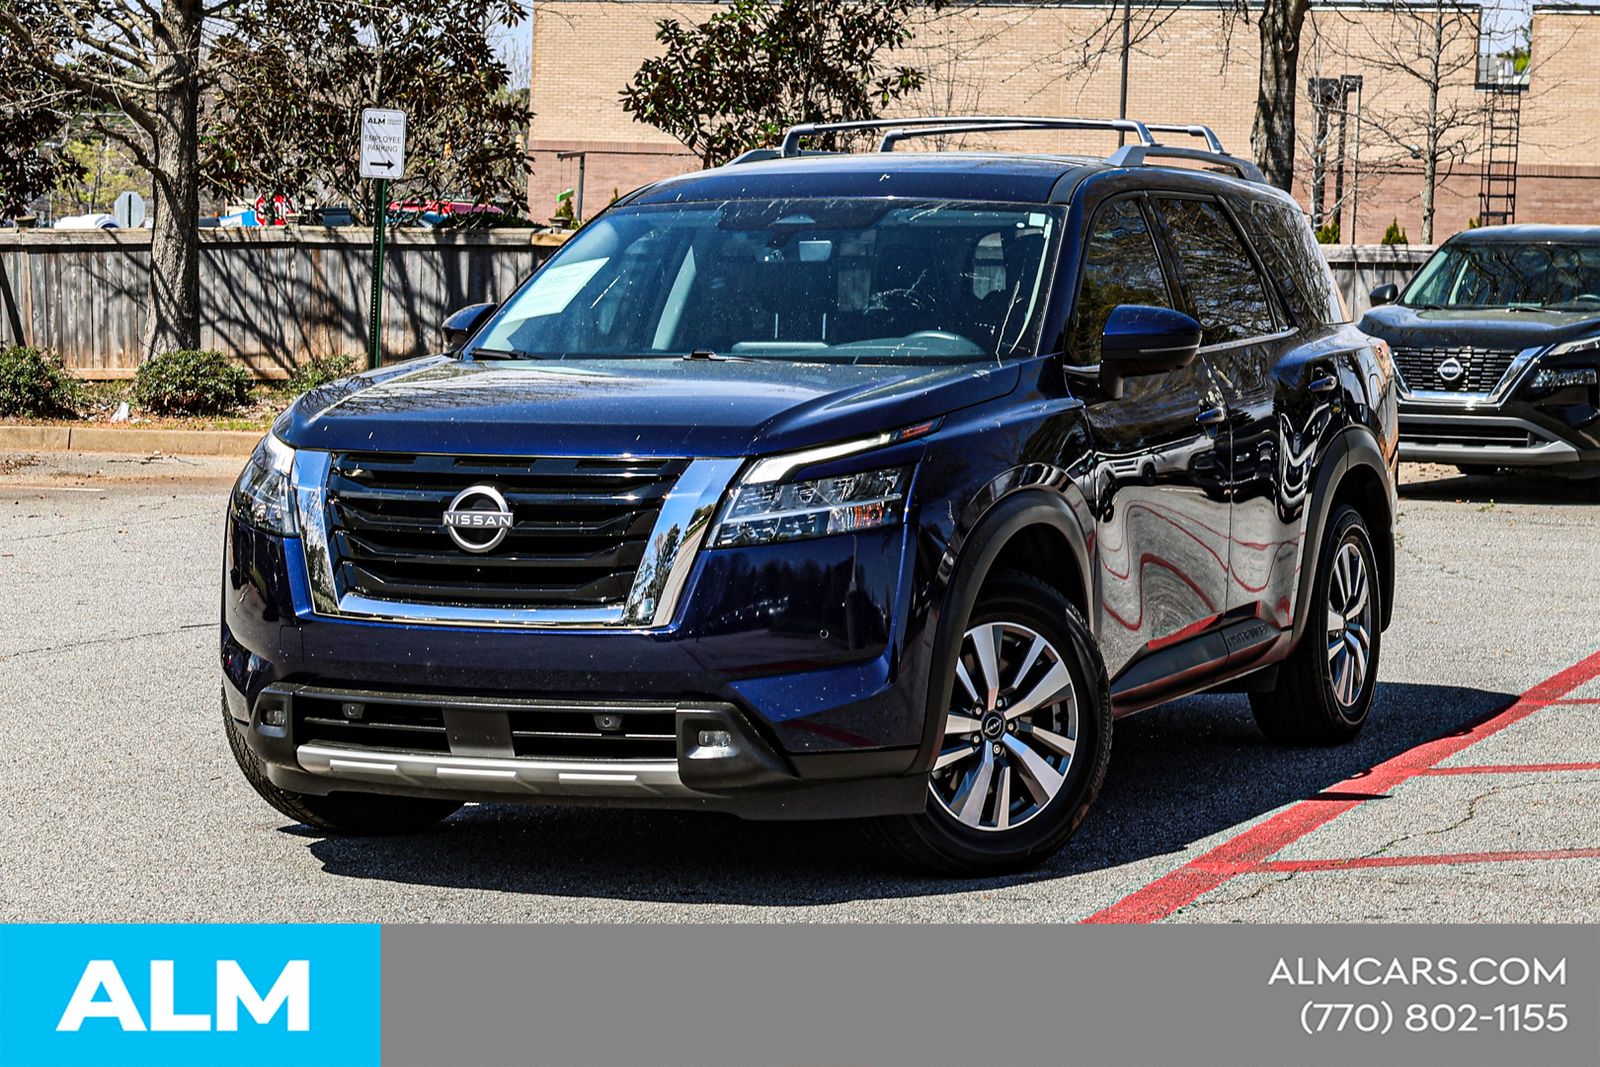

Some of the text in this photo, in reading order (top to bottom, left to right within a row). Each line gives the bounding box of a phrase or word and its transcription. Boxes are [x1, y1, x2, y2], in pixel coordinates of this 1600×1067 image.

[367, 117, 386, 125] ALM
[364, 134, 402, 144] EMPLOYEE
[367, 143, 398, 153] PARKING
[444, 514, 511, 526] NISSAN
